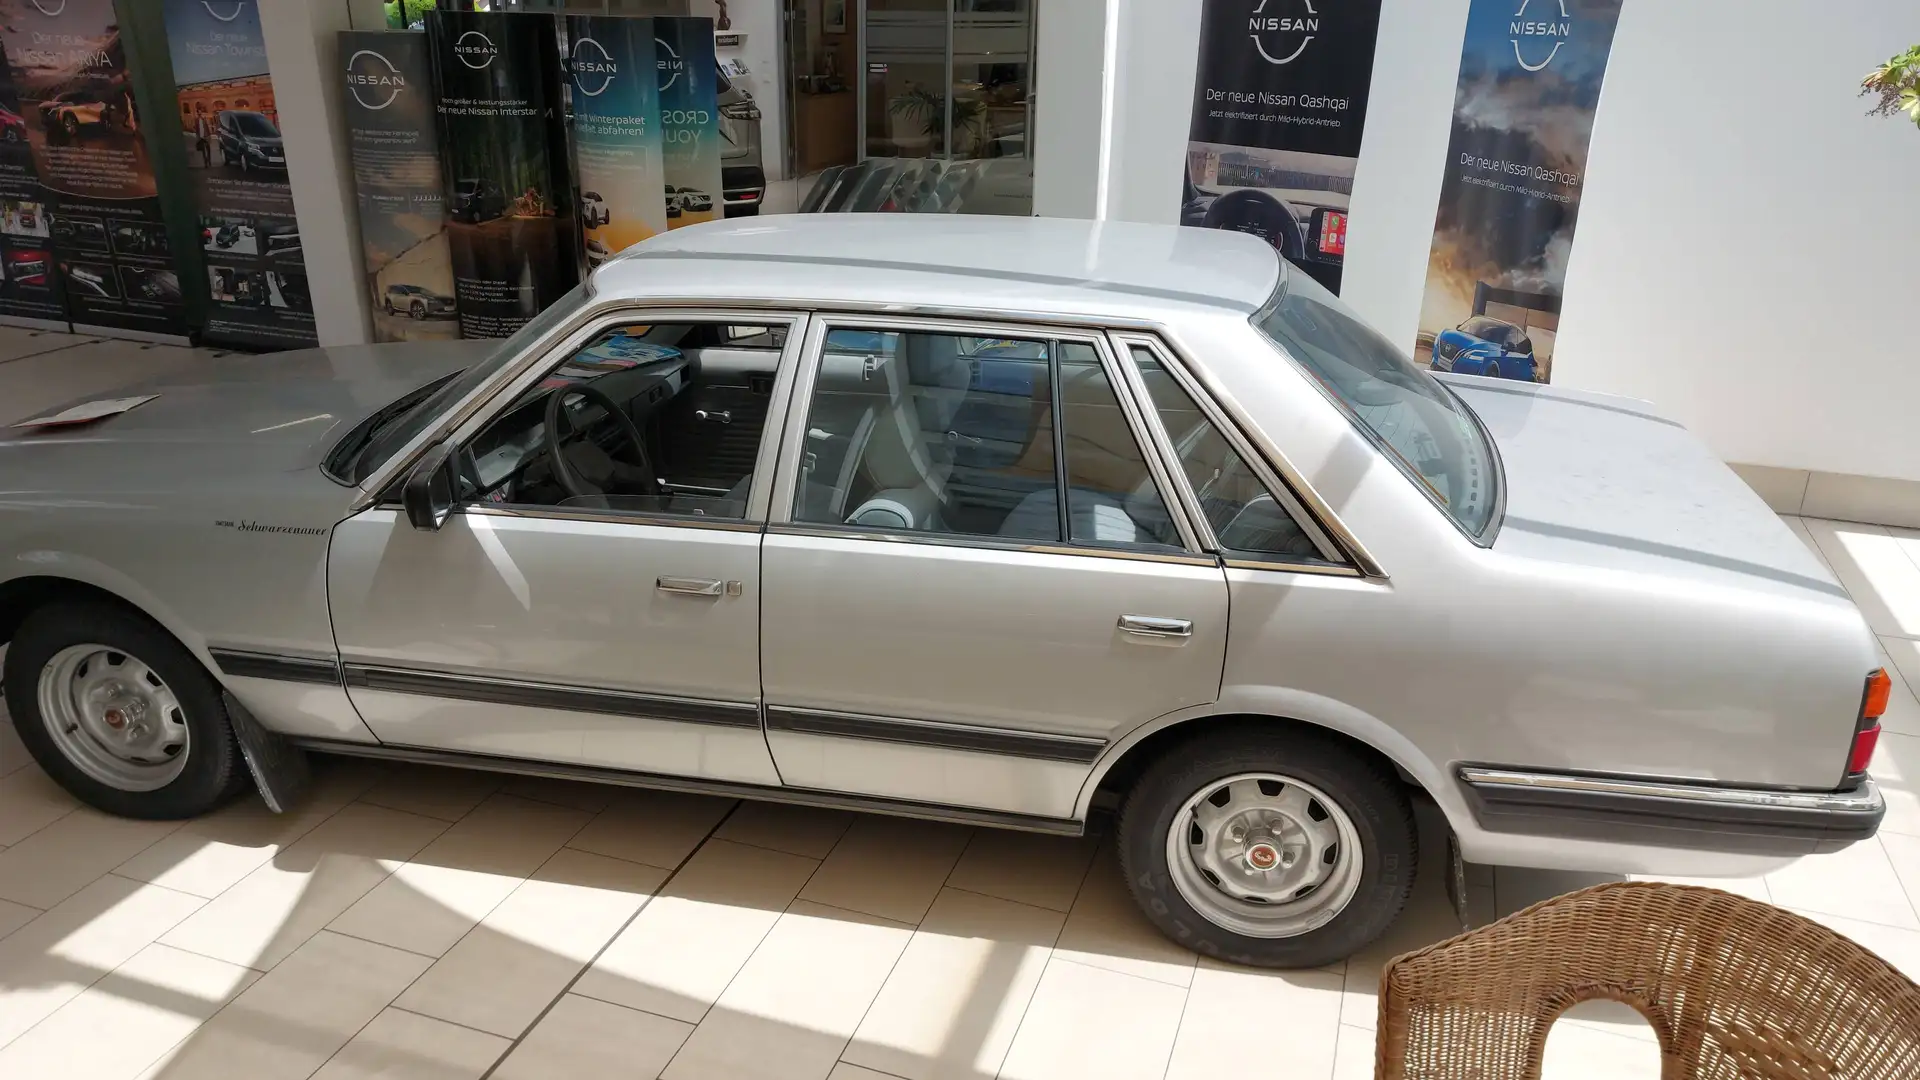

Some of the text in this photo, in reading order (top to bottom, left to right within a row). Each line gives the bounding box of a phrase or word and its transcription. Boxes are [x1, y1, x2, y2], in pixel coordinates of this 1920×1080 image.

[1249, 17, 1319, 31] NISSAN
[1509, 21, 1570, 36] NISSAN
[185, 42, 223, 55] Nissan
[454, 46, 498, 54] NISSAN
[68, 49, 114, 68] ARIYA
[571, 61, 617, 73] NISSAN
[346, 74, 405, 86] NISSAN
[1206, 88, 1350, 112] Der neue Nissan Qashqai
[437, 104, 447, 114] Der
[448, 107, 467, 115] neue
[468, 107, 498, 116] Nissan
[500, 108, 538, 116] Interstar
[1208, 109, 1224, 118] Jetzt
[1259, 113, 1277, 122] durch
[589, 113, 646, 126] Winterpaket
[598, 125, 644, 136] abfahren!
[1460, 152, 1580, 187] Der neue Nissan Qashqai
[238, 519, 328, 536] Schwarzenauer
